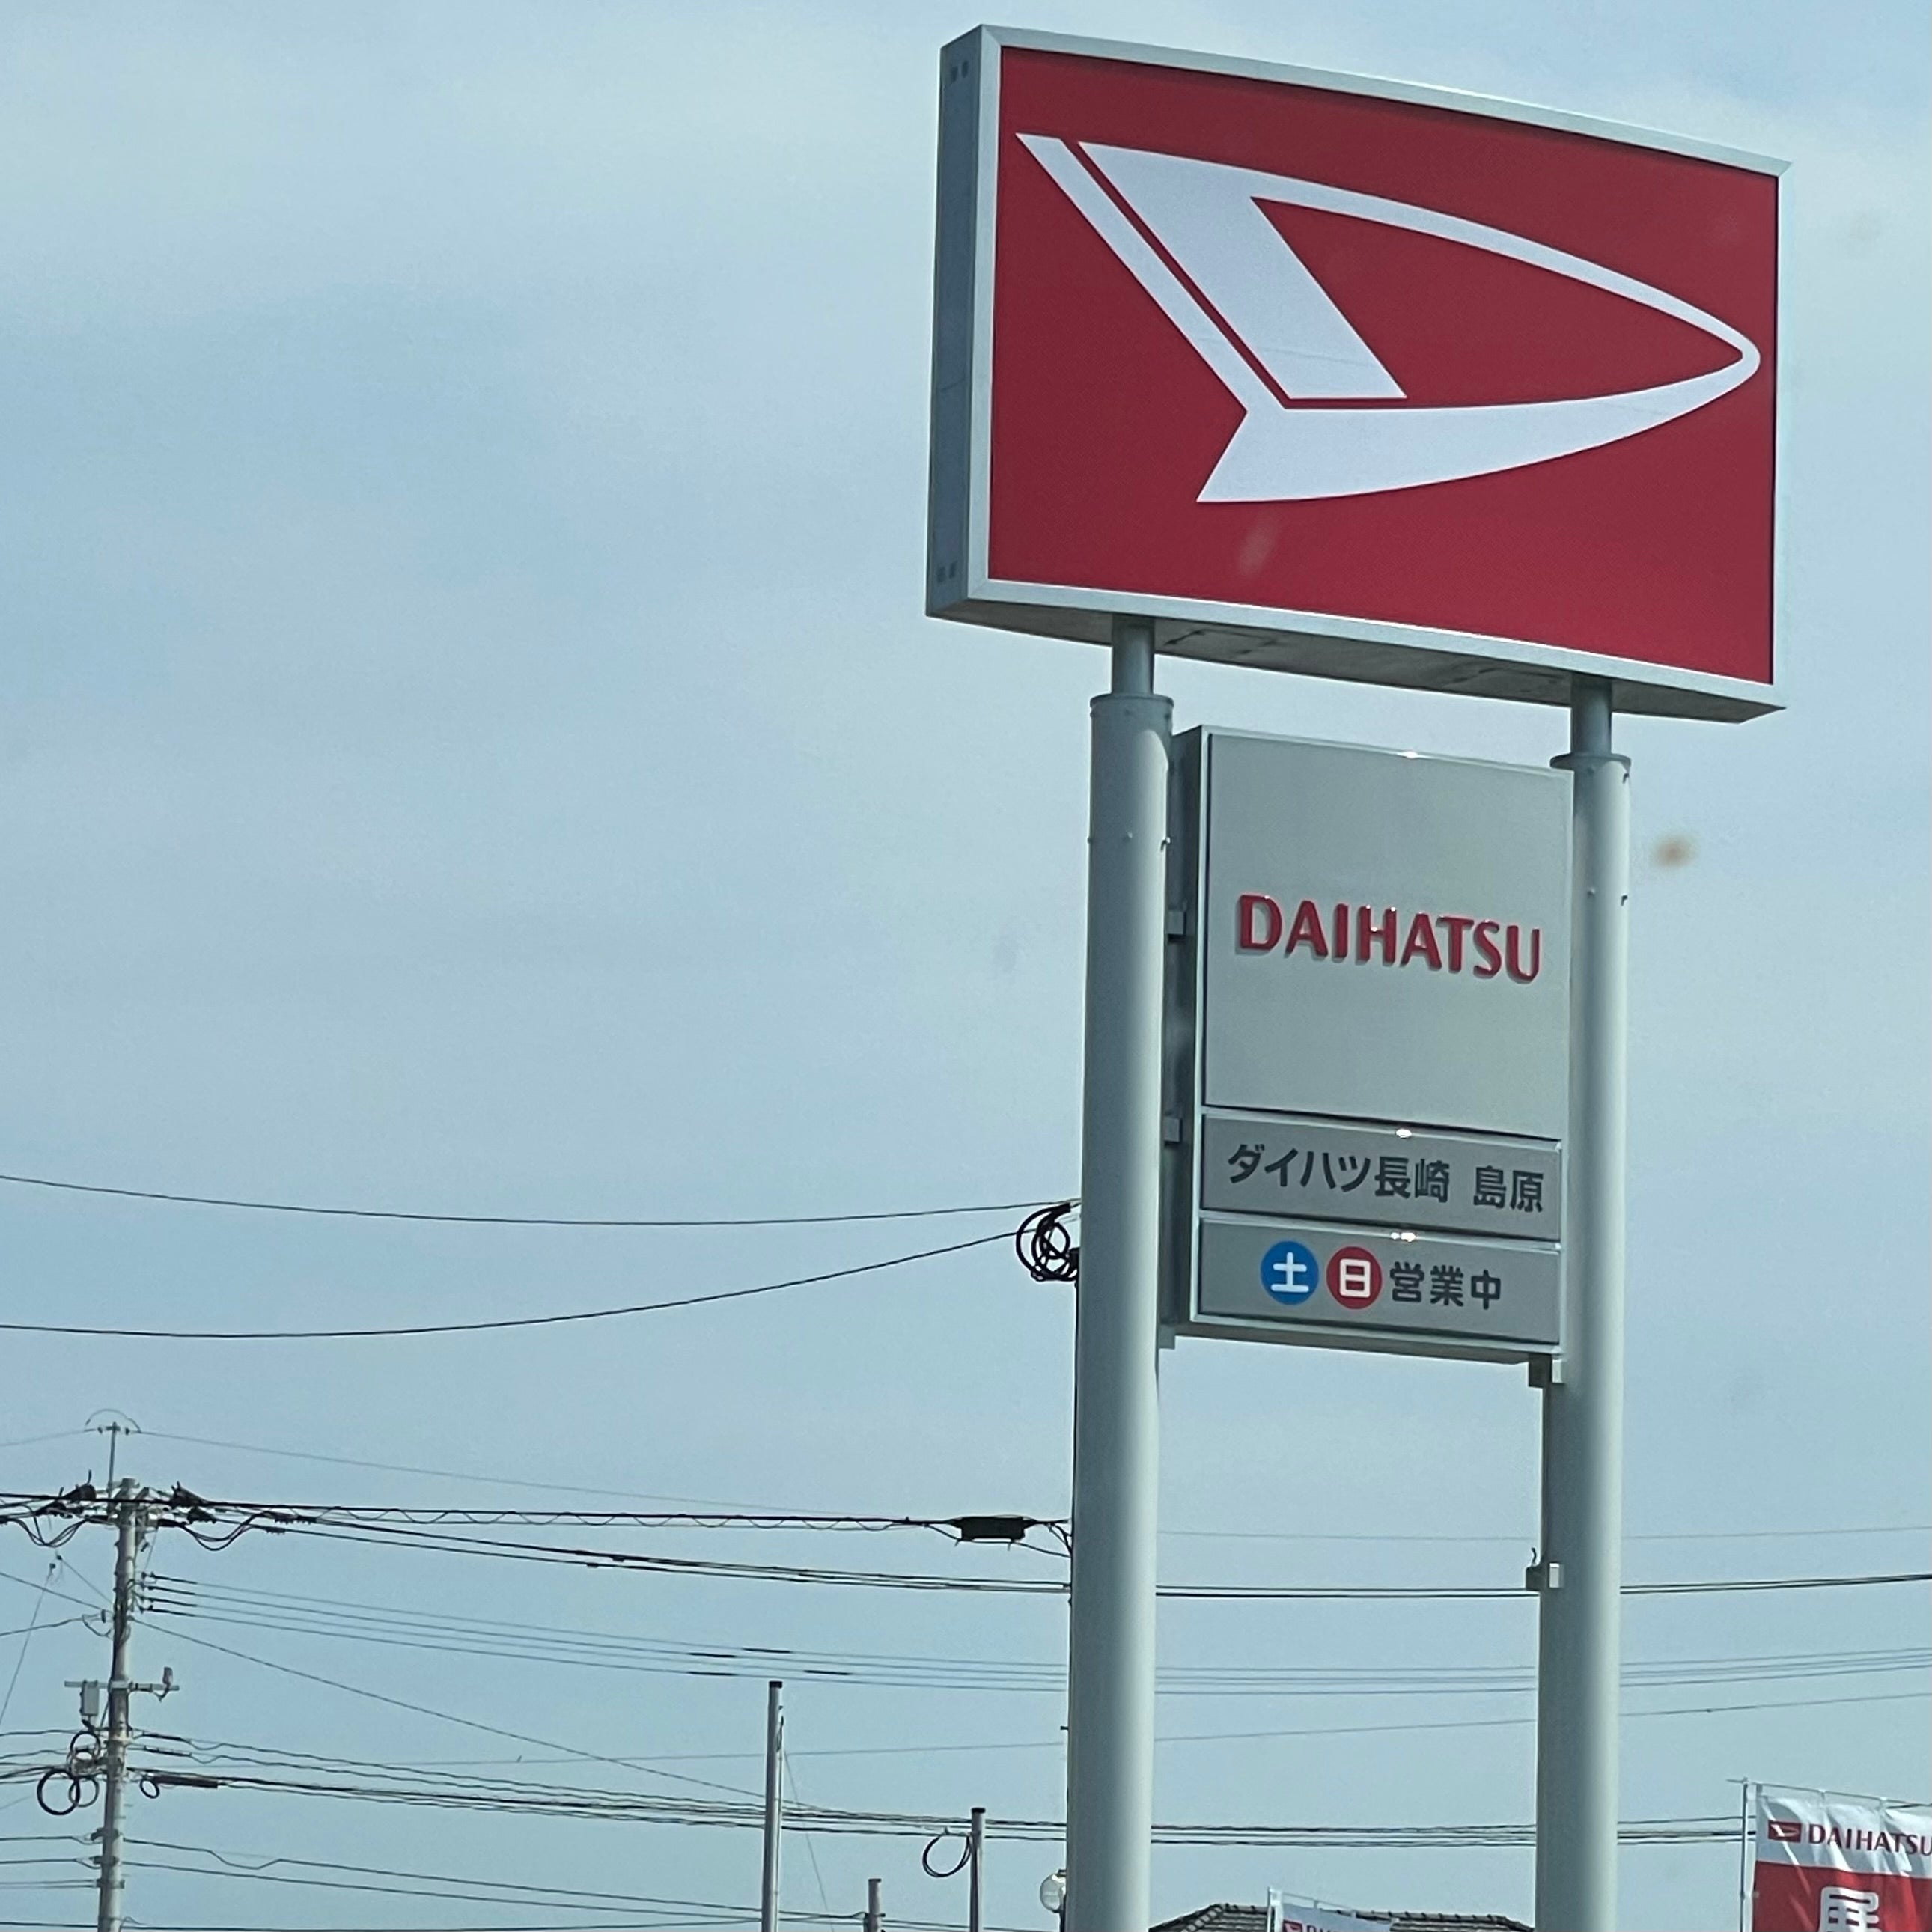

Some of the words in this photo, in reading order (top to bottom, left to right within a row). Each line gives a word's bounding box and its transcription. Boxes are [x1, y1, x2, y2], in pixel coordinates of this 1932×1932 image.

[1237, 893, 1541, 984] DAIHATSU
[1228, 1143, 1451, 1203] ダイハツ長崎
[1473, 1165, 1544, 1213] 島原
[1808, 1823, 1932, 1856] DAIHATSU
